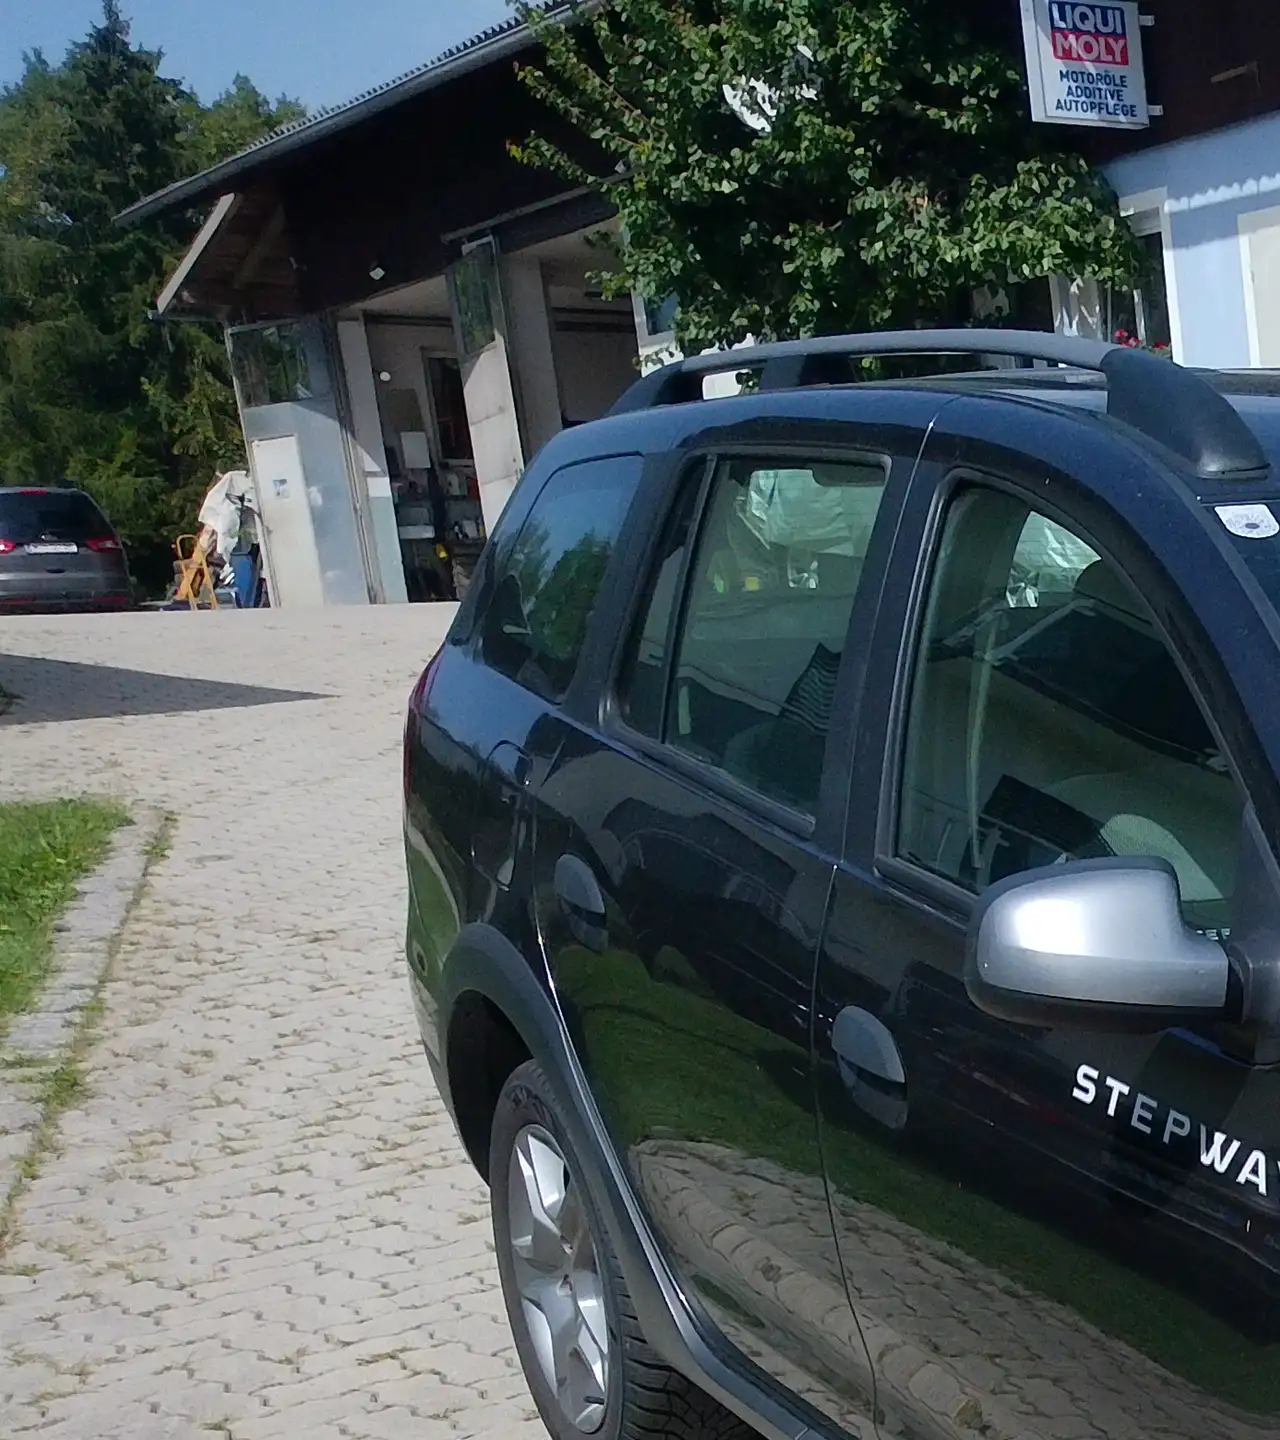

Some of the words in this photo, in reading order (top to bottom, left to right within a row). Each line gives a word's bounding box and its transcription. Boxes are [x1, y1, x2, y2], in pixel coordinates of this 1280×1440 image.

[1052, 3, 1123, 34] LIQUI
[1055, 33, 1126, 62] MOLY
[1060, 69, 1128, 88] MOTORÖLE
[1066, 85, 1125, 102] ADDITIVE
[1055, 98, 1138, 117] AUTOPFLEGE
